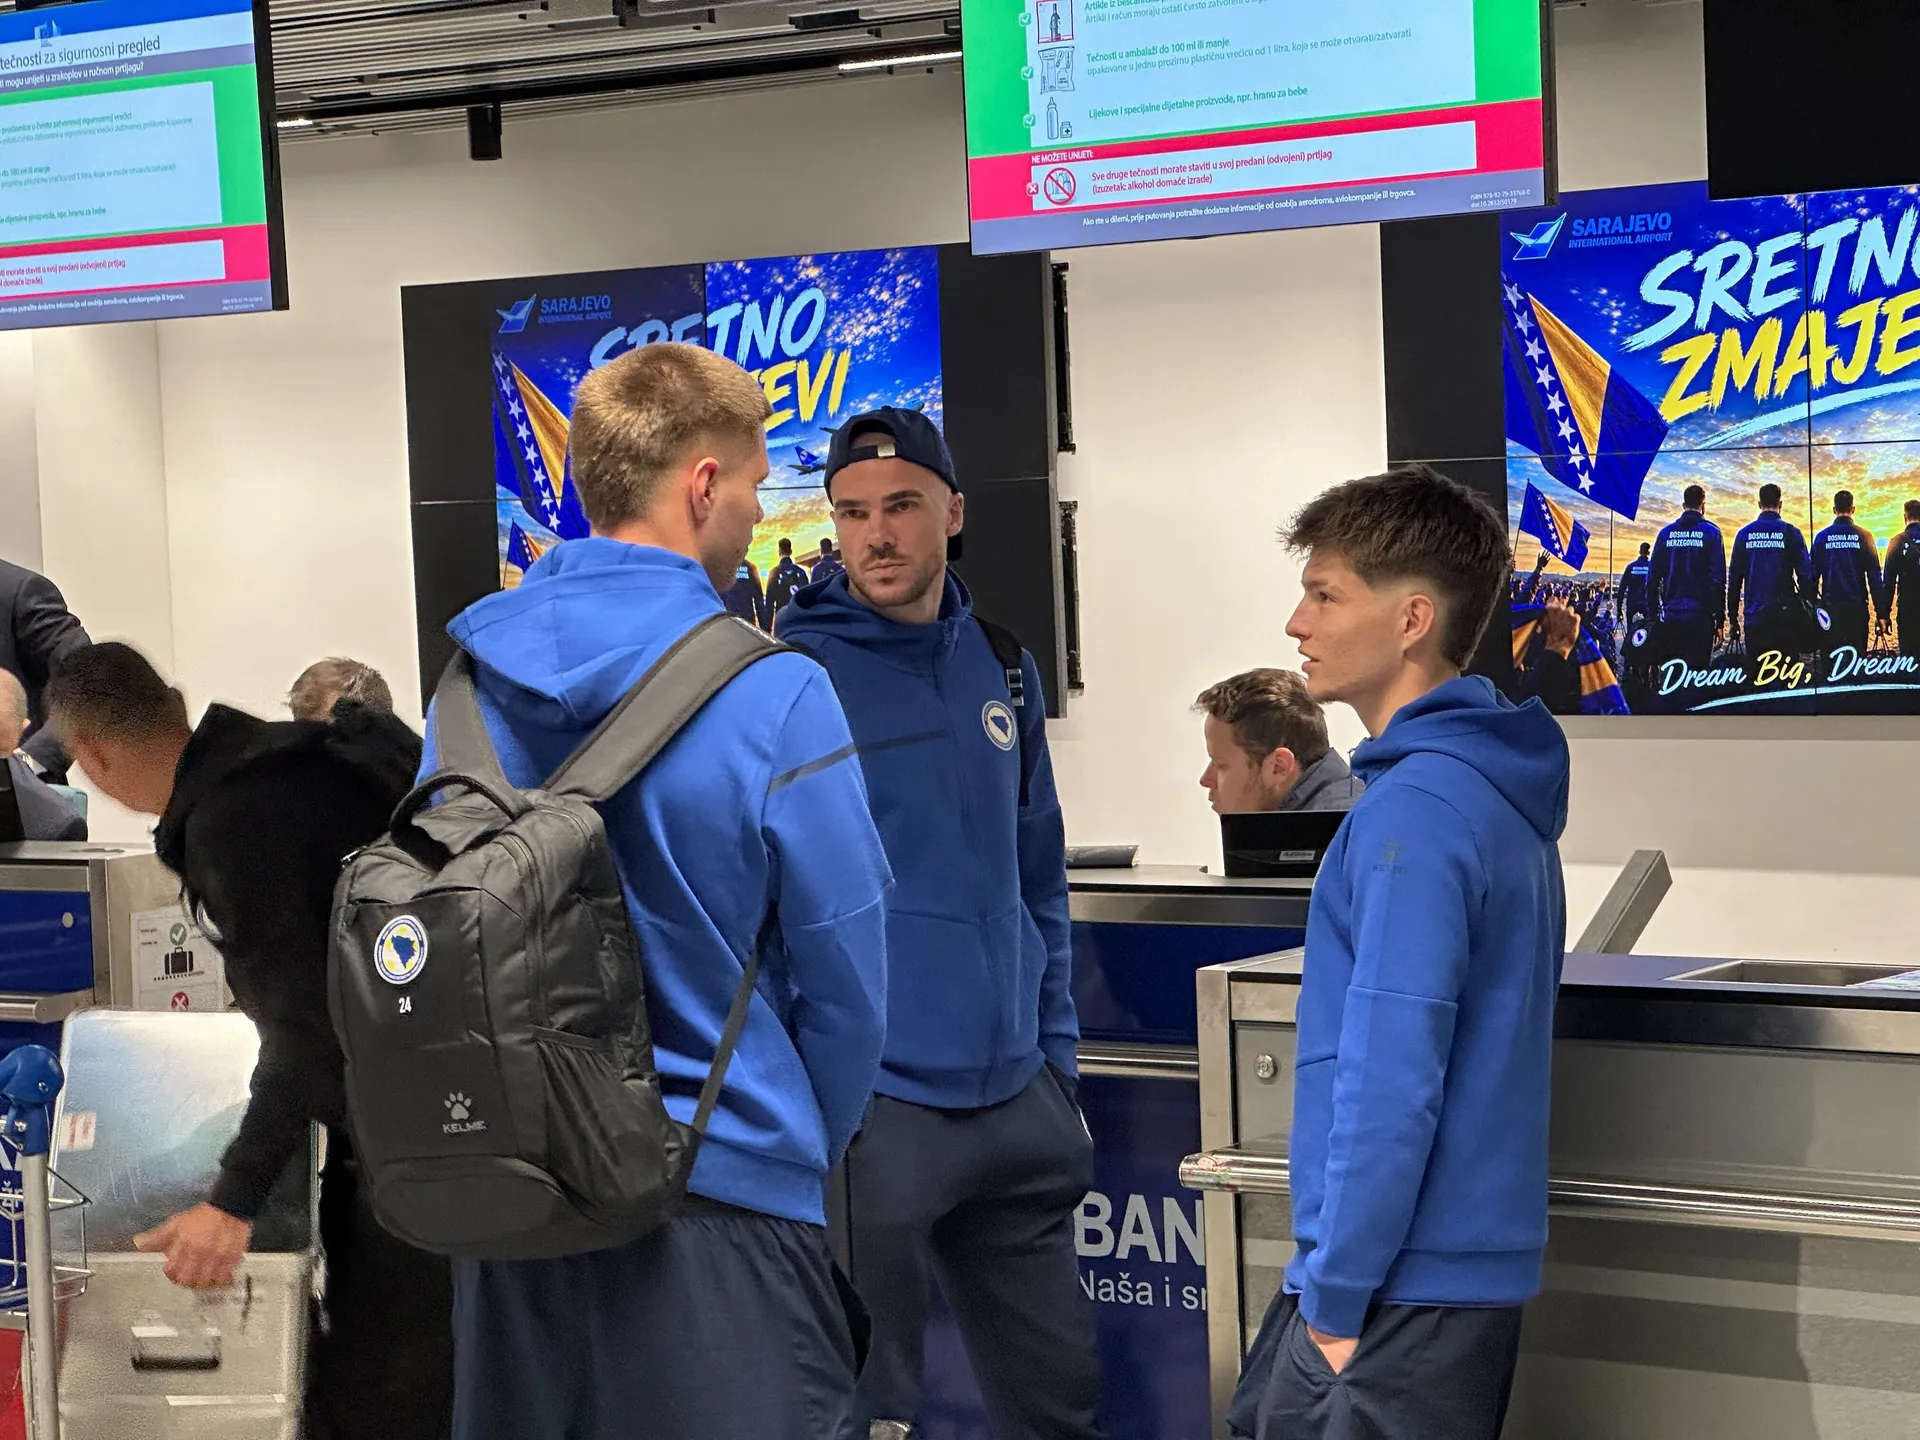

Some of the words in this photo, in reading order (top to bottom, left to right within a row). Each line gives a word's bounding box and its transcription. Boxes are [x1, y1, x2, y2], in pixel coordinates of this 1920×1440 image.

[1085, 13, 1107, 24] Artikli
[1112, 11, 1132, 20] račun
[1133, 6, 1160, 18] moraju
[1161, 3, 1182, 14] ostati
[1184, 1, 1206, 11] čvrsto
[0, 51, 41, 70] tečnosti
[44, 52, 56, 64] za
[59, 41, 115, 65] sigurnosni
[118, 35, 160, 58] pregled
[1086, 51, 1117, 63] Tečnosti
[1125, 45, 1158, 58] ambalaži
[1159, 45, 1169, 54] do
[1172, 42, 1185, 52] 100
[1186, 41, 1196, 50] ml
[1206, 38, 1230, 49] manje
[1087, 64, 1128, 76] upakovane
[1135, 60, 1156, 73] jednu
[1158, 56, 1189, 69] prozirnu
[1191, 52, 1225, 66] plastičnu
[1255, 46, 1266, 55] od
[1273, 44, 1291, 53] litra,
[1292, 42, 1308, 52] koja
[1310, 41, 1318, 49] se
[1320, 38, 1341, 48] može
[1343, 28, 1411, 45] otvarati/zatvarati
[5, 78, 24, 88] mogu
[25, 74, 44, 86] unijeti
[51, 69, 82, 82] zrakoplov
[89, 66, 114, 76] ručnom
[115, 61, 144, 76] prtljagu?
[1089, 108, 1119, 119] Lijekove
[1124, 103, 1160, 116] specijalne
[1161, 99, 1195, 112] dijetalne
[1196, 94, 1235, 108] proizvode,
[1237, 93, 1252, 103] npr.
[1253, 91, 1276, 100] hranu
[1277, 89, 1286, 98] za
[1287, 86, 1308, 97] bebe
[1031, 155, 1040, 164] NE
[1041, 152, 1067, 163] MOŽETE
[1092, 172, 1105, 181] Sve
[1106, 170, 1128, 181] druge
[1129, 166, 1159, 178] tečnosti
[1161, 165, 1187, 175] morate
[1188, 161, 1211, 172] staviti
[1218, 158, 1235, 170] svoj
[1235, 155, 1265, 169] predani
[1266, 151, 1305, 165] (odvojeni)
[1307, 149, 1332, 162] prtljag
[1092, 182, 1126, 195] (izuzetak:
[1128, 179, 1155, 190] alkohol
[1156, 176, 1186, 188] domaće
[1187, 173, 1213, 185] izrade)
[1083, 218, 1094, 226] Ako
[1095, 217, 1104, 225] ste
[1110, 214, 1130, 224] dilemi,
[1130, 213, 1144, 223] prije
[1145, 210, 1175, 222] putovanja
[1176, 208, 1203, 219] potražite
[1204, 206, 1229, 215] dodatne
[1231, 202, 1265, 213] informacije
[1266, 201, 1274, 209] od
[1299, 196, 1334, 206] aerodroma,
[1335, 191, 1382, 203] aviokompanije
[1389, 189, 1416, 200] trgovca.
[1572, 212, 1672, 236] SARAJEVO
[1569, 235, 1633, 248] INTERNATIONAL
[1634, 232, 1673, 244] AIRPORT
[1619, 203, 1920, 353] SRETN
[541, 294, 611, 313] SARAJEVO
[1658, 288, 1920, 423] ZMAJE
[1666, 539, 1703, 548] HERZEGOVINA
[1669, 531, 1690, 539] BOSNIA
[1690, 531, 1703, 539] AND
[1745, 540, 1785, 549] HERZEGOVINA
[1748, 532, 1770, 540] BOSNIA
[1770, 532, 1783, 540] AND
[1825, 541, 1860, 550] HERZEGOVINA
[1827, 534, 1847, 542] BOSNIA
[1847, 534, 1859, 542] AND
[1658, 658, 1747, 695] Dream
[1753, 649, 1812, 688] Big,
[1827, 645, 1918, 684] Dream
[398, 996, 412, 1014] 24
[443, 1120, 488, 1134] KELME
[1073, 1191, 1206, 1266] BAN
[1080, 1269, 1153, 1306] Naša
[1164, 1276, 1170, 1308] i
